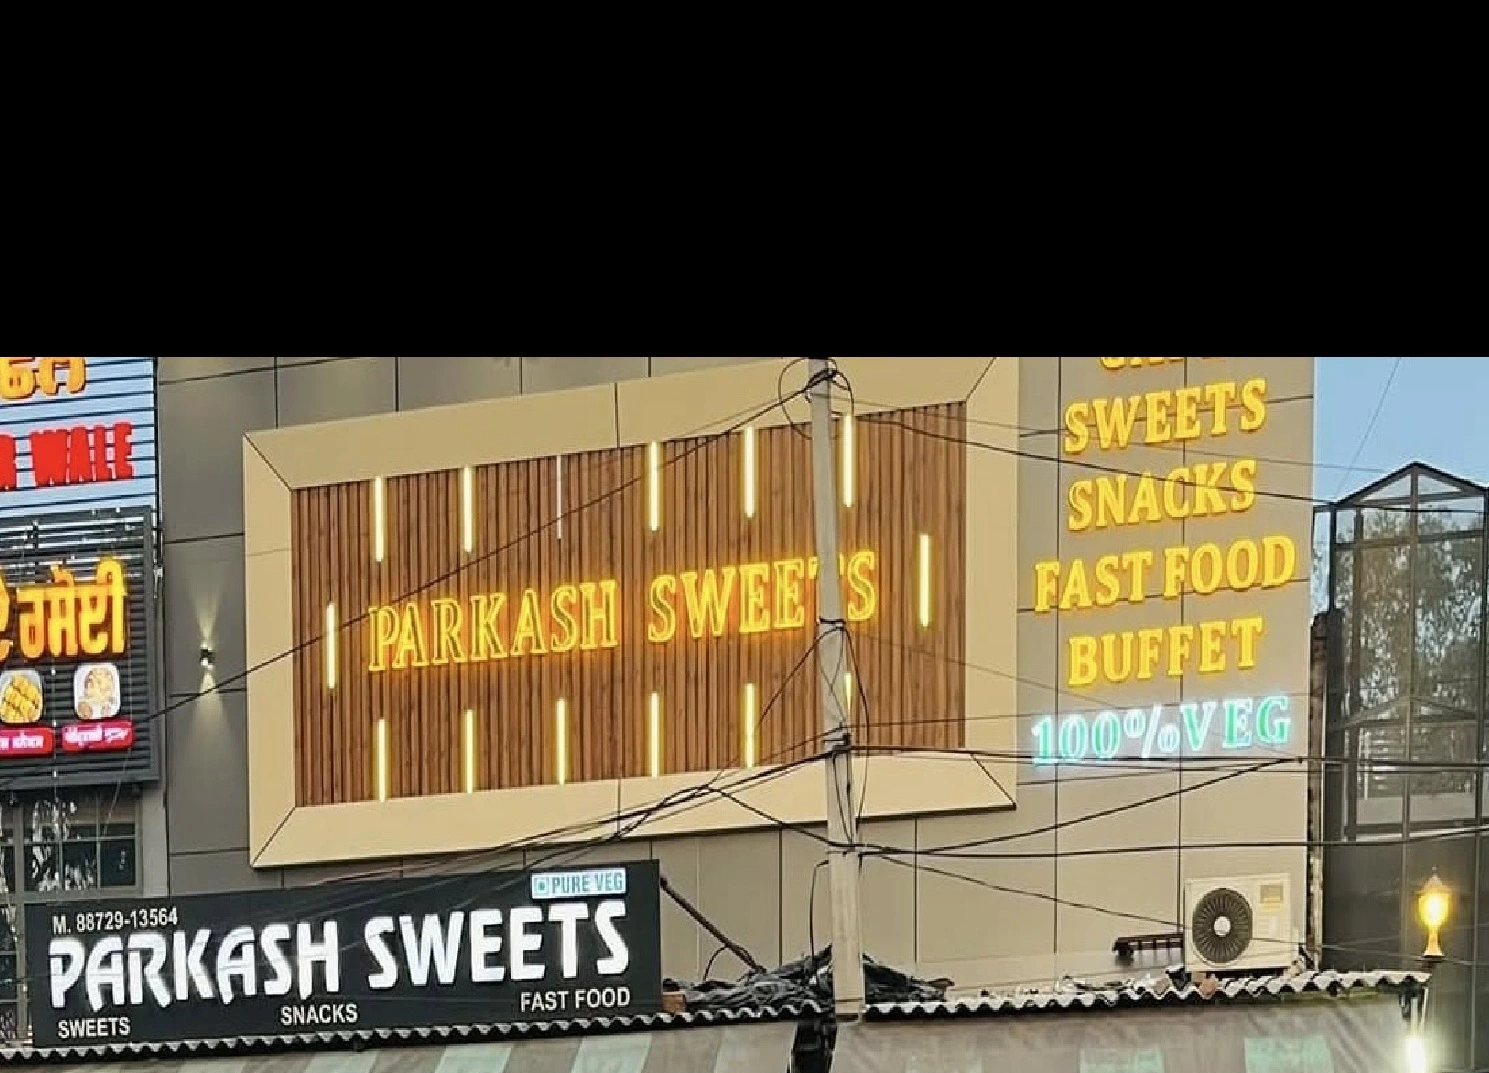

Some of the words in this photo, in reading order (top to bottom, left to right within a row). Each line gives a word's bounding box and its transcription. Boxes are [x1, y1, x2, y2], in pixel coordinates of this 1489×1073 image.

[1064, 378, 1267, 453] SWEETS
[30, 422, 133, 487] WALE
[1068, 459, 1257, 531] SNACKS
[1033, 550, 1153, 612] FAST
[1163, 535, 1296, 600] FOOD
[368, 579, 618, 671] PARKASH
[1068, 617, 1263, 686] BUFFET
[552, 874, 590, 894] PURE
[594, 871, 623, 892] VEG
[49, 920, 340, 1012] PARKASH
[364, 899, 630, 989] SWEETS
[53, 915, 71, 935] M.
[76, 907, 178, 932] 88729-13564
[57, 1017, 131, 1039] SWEETS
[280, 1003, 359, 1026] SNACKS
[520, 991, 569, 1012] FAST
[575, 987, 630, 1009] FOOD
